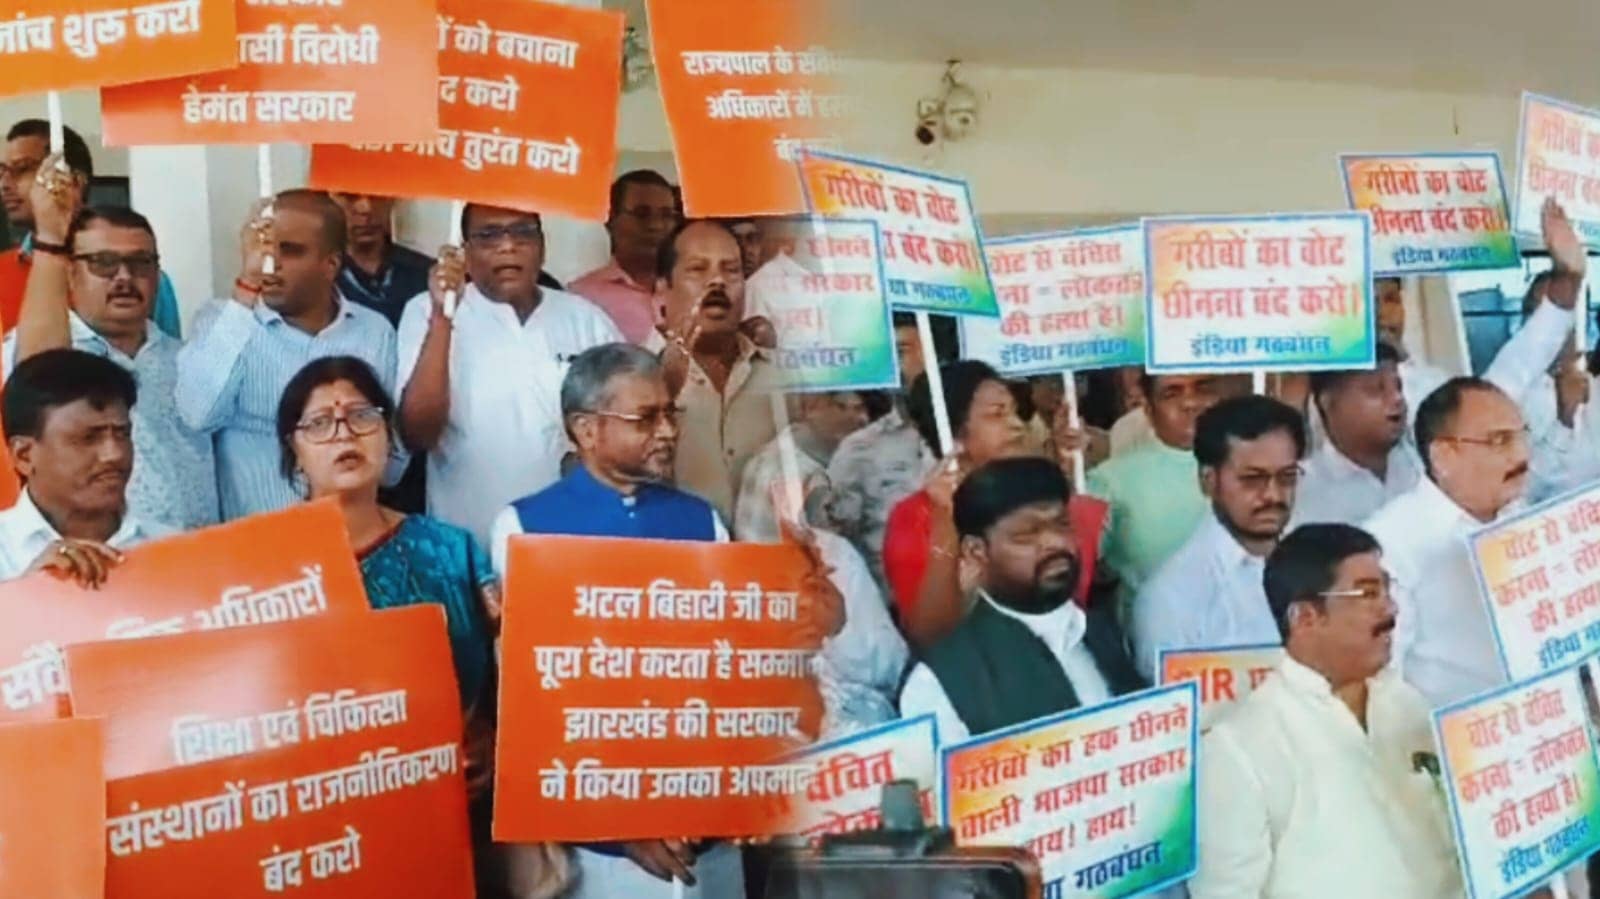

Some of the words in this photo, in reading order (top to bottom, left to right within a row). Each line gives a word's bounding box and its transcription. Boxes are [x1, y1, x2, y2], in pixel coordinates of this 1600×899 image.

[236, 25, 286, 64] ासी
[292, 23, 380, 65] विरोधी
[453, 20, 491, 55] को
[495, 30, 579, 69] बचाना
[681, 50, 771, 75] राज्यपाल
[773, 46, 793, 74] के
[181, 85, 250, 123] हेमंत
[254, 90, 356, 122] सरकार
[464, 75, 520, 112] करो
[706, 88, 791, 119] अधिकारों
[461, 127, 522, 171] तुरंत
[526, 136, 581, 175] करो
[1423, 170, 1449, 195] का
[1453, 162, 1489, 194] वोट
[889, 187, 922, 219] का
[922, 184, 960, 225] वोट
[1370, 203, 1424, 236] ीनना
[1031, 245, 1053, 270] से
[1253, 236, 1293, 269] का
[1297, 228, 1346, 268] वोट
[1162, 280, 1245, 321] छीनना
[1250, 276, 1290, 318] बंद
[1001, 310, 1031, 337] की
[574, 585, 644, 620] अटल
[648, 578, 727, 622] बिहारी
[731, 581, 763, 622] जी
[766, 590, 800, 622] का
[1527, 598, 1558, 632] की
[533, 645, 584, 690] पूरा
[588, 637, 634, 679] देश
[639, 647, 711, 680] करता
[714, 638, 735, 680] है
[171, 714, 253, 766] शिक्षा
[258, 699, 302, 748] एवं
[307, 688, 408, 742] चिकित्सा
[562, 699, 670, 742] झारखंड
[674, 697, 710, 739] की
[714, 705, 802, 738] सरकार
[1041, 740, 1072, 768] का
[1084, 724, 1120, 757] हक
[1129, 703, 1189, 741] छीनने
[105, 780, 243, 857] संस्थानों
[248, 781, 290, 824] का
[291, 742, 459, 813] राजनीतिकरण
[539, 758, 568, 801] ने
[573, 757, 643, 801] किया
[646, 766, 723, 800] उनका
[960, 793, 1024, 841] वाली
[1034, 772, 1109, 815] भाजपा
[1118, 747, 1188, 789] सरकार
[1457, 760, 1513, 804] करना
[1491, 798, 1522, 839] की
[259, 845, 303, 893] बंद
[307, 825, 362, 880] करो
